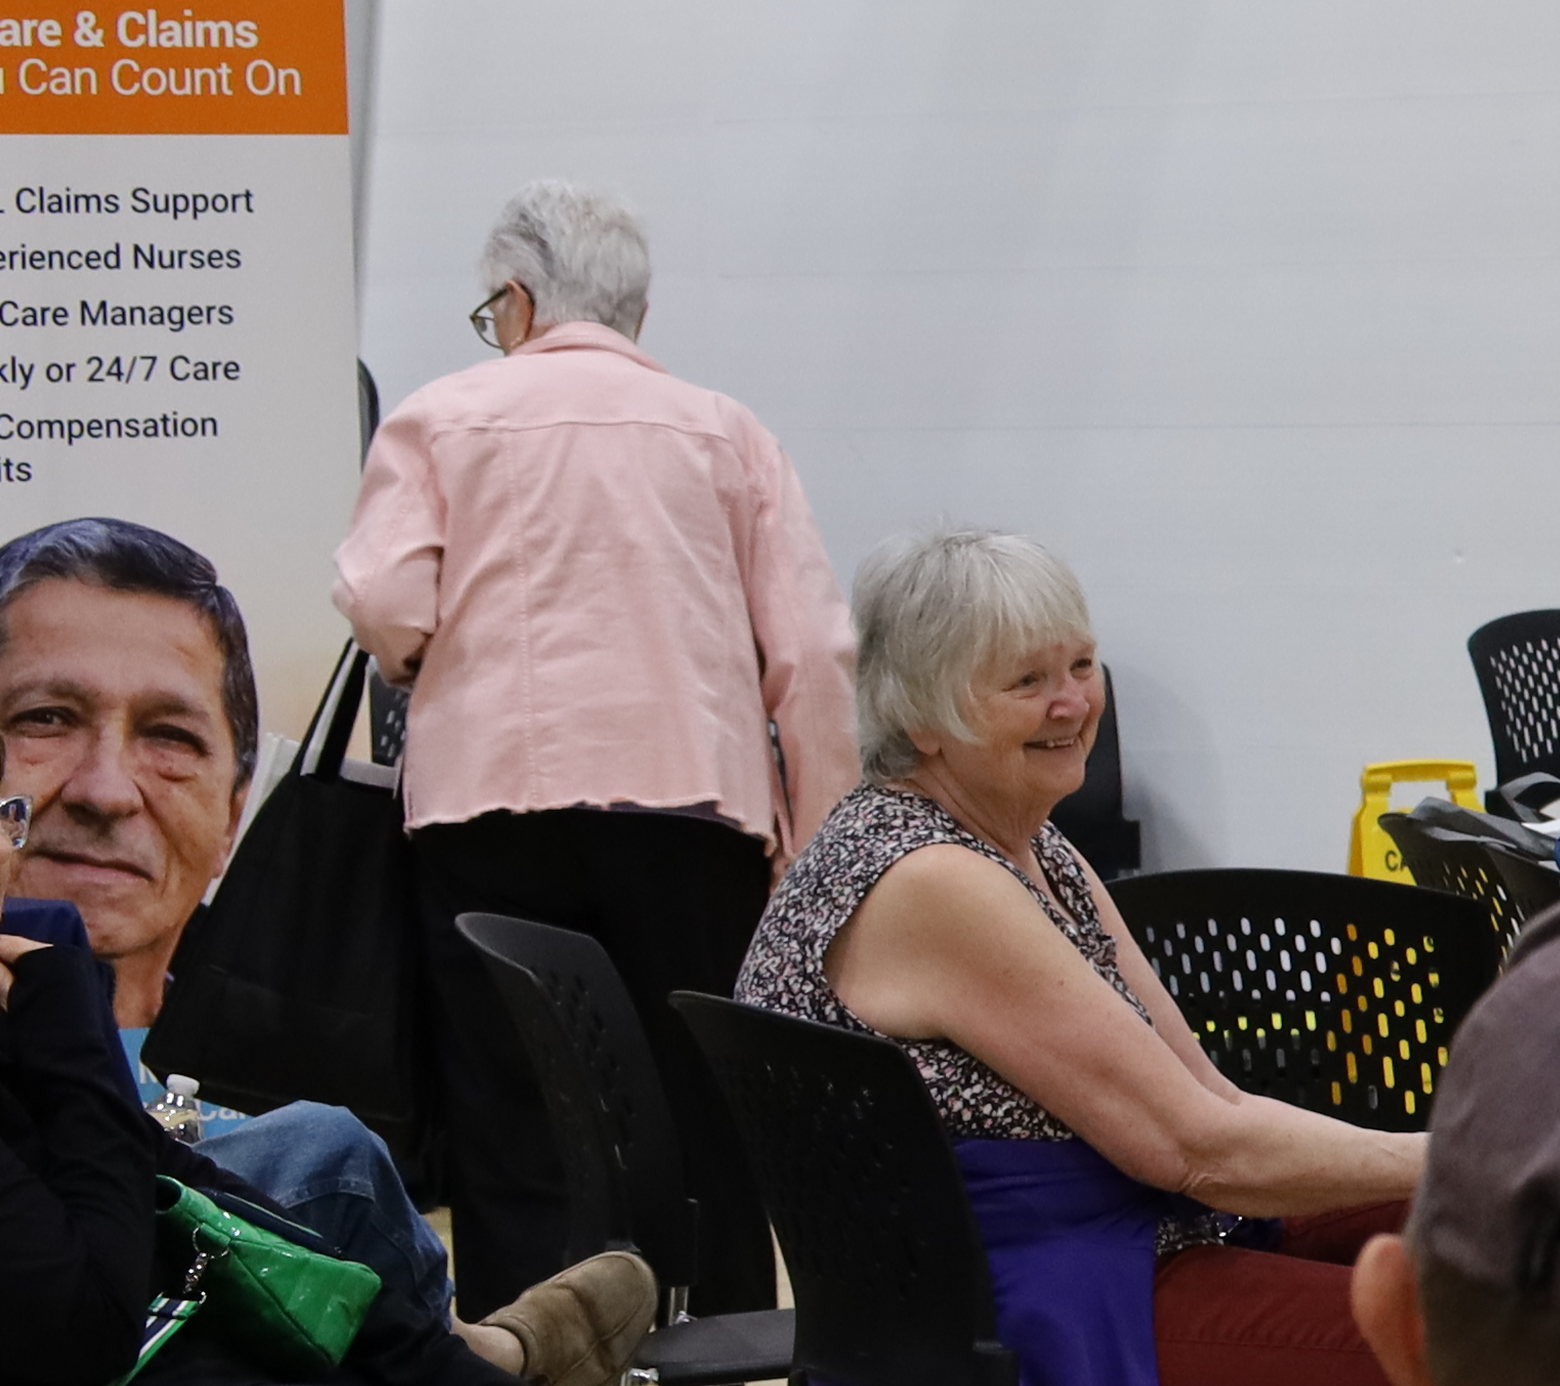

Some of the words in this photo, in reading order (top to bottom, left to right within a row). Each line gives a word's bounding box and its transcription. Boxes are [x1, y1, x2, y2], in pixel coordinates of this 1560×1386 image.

[73, 11, 104, 47] &
[117, 9, 258, 48] Claims
[18, 58, 97, 95] Can
[111, 58, 233, 95] Count
[246, 59, 301, 95] On
[16, 186, 119, 214] Claims
[131, 187, 253, 220] Support
[133, 244, 241, 269] Nurses
[0, 300, 68, 327] Care
[80, 300, 233, 332] Managers
[46, 363, 76, 383] or
[87, 356, 157, 383] 24/7
[170, 355, 240, 381] Care
[0, 411, 217, 446] Compensation
